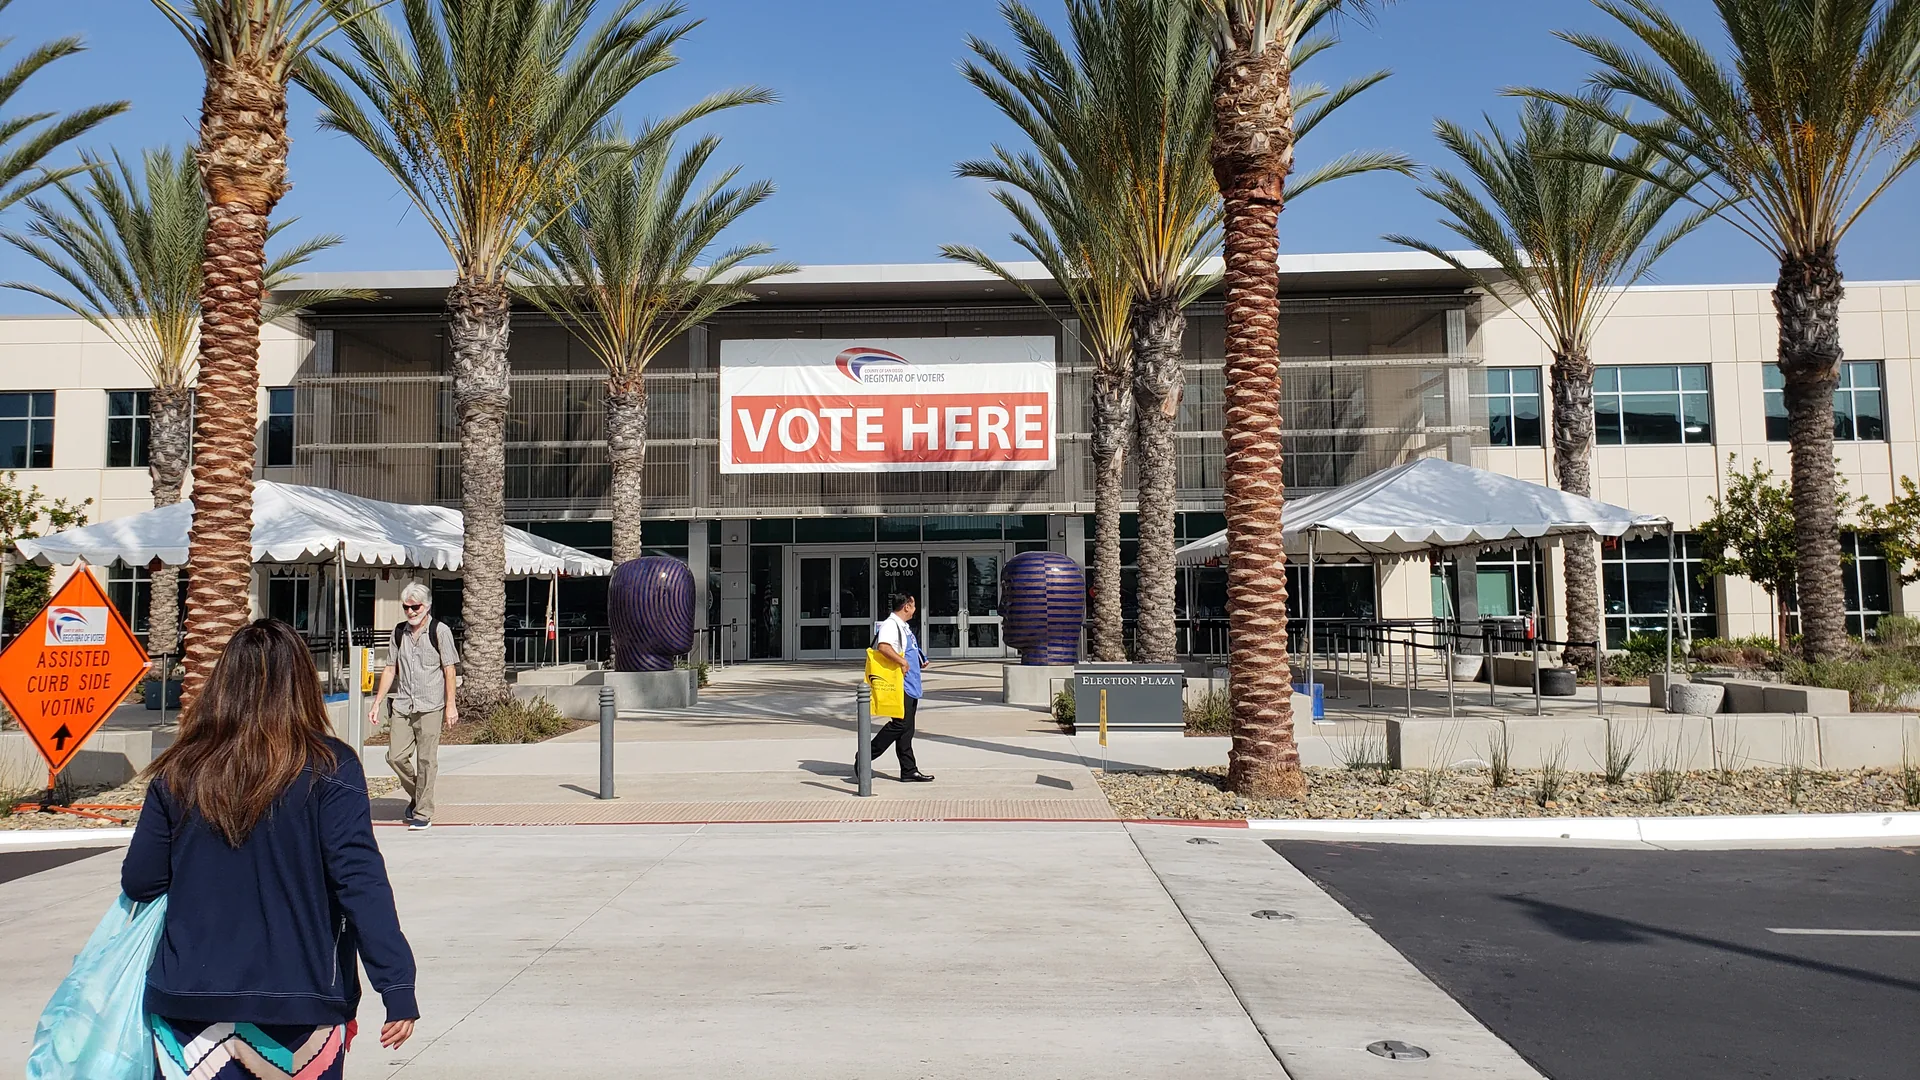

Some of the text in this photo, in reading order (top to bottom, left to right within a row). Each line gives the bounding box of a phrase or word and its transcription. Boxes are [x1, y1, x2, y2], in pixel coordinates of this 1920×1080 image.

[864, 373, 945, 383] REGISTRAR OF VOTERS
[736, 404, 1044, 454] VOTE HERE
[879, 557, 919, 568] 5600
[902, 569, 914, 577] 100
[36, 650, 110, 669] ASSISTED
[27, 673, 112, 693] CURB SIDE
[1082, 676, 1175, 685] ELECTION PLAZA
[40, 697, 95, 717] VOTING
